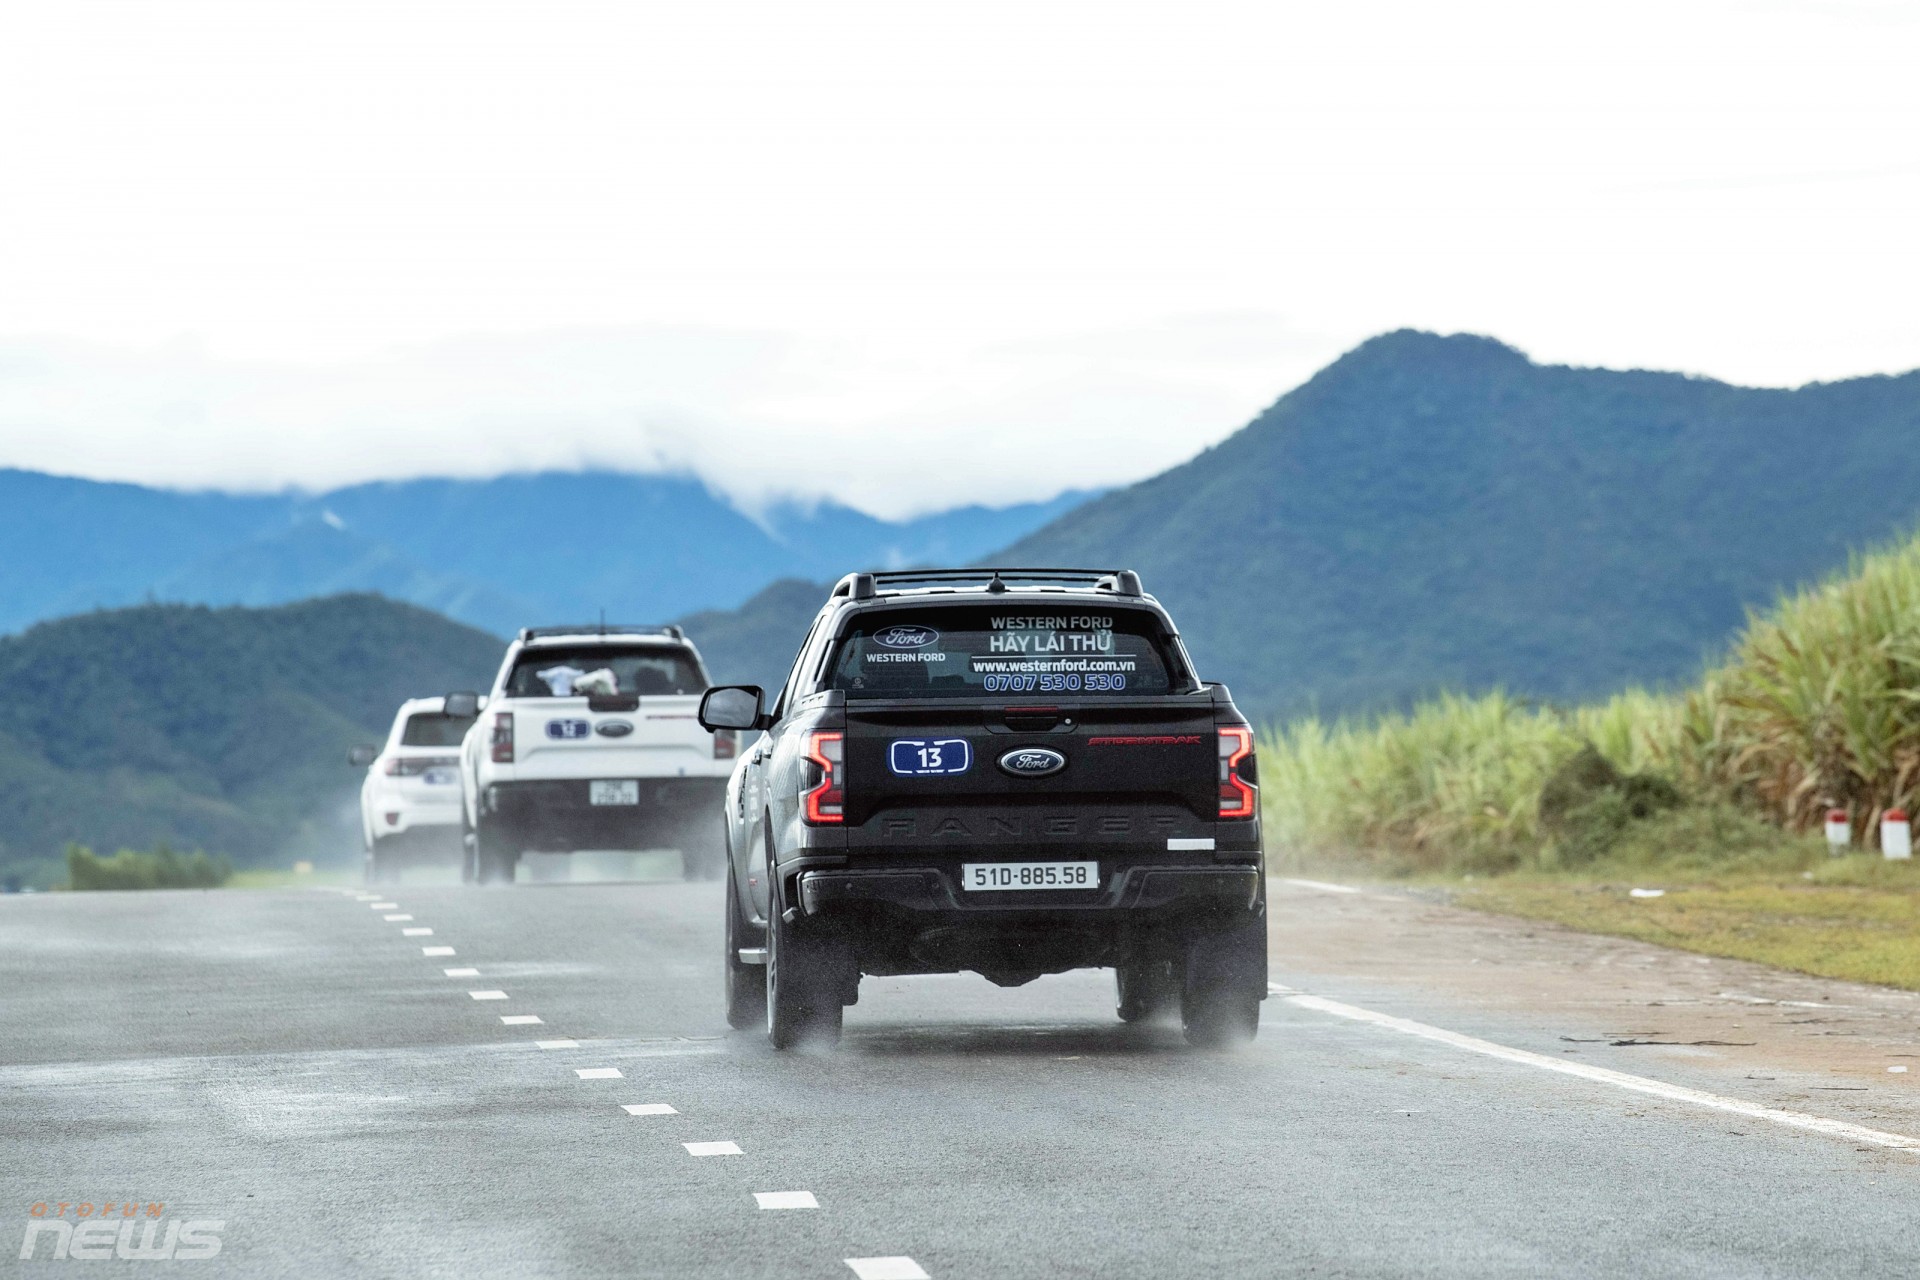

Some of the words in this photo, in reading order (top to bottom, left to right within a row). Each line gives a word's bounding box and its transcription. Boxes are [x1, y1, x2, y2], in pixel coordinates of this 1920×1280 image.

[991, 616, 1067, 629] WESTERN
[1070, 616, 1113, 628] FORD
[886, 628, 927, 644] Ford
[990, 631, 1031, 652] HÃY
[1034, 631, 1065, 651] LÁI
[866, 653, 916, 662] WESTERN
[918, 653, 946, 662] FORD
[973, 659, 1136, 672] www.westernford.com.vn
[984, 674, 1037, 691] 0707
[1040, 674, 1081, 691] 530
[1084, 674, 1126, 690] 530
[917, 748, 942, 767] 13
[1016, 754, 1050, 768] Ford
[975, 867, 1087, 886] 51D-885.58
